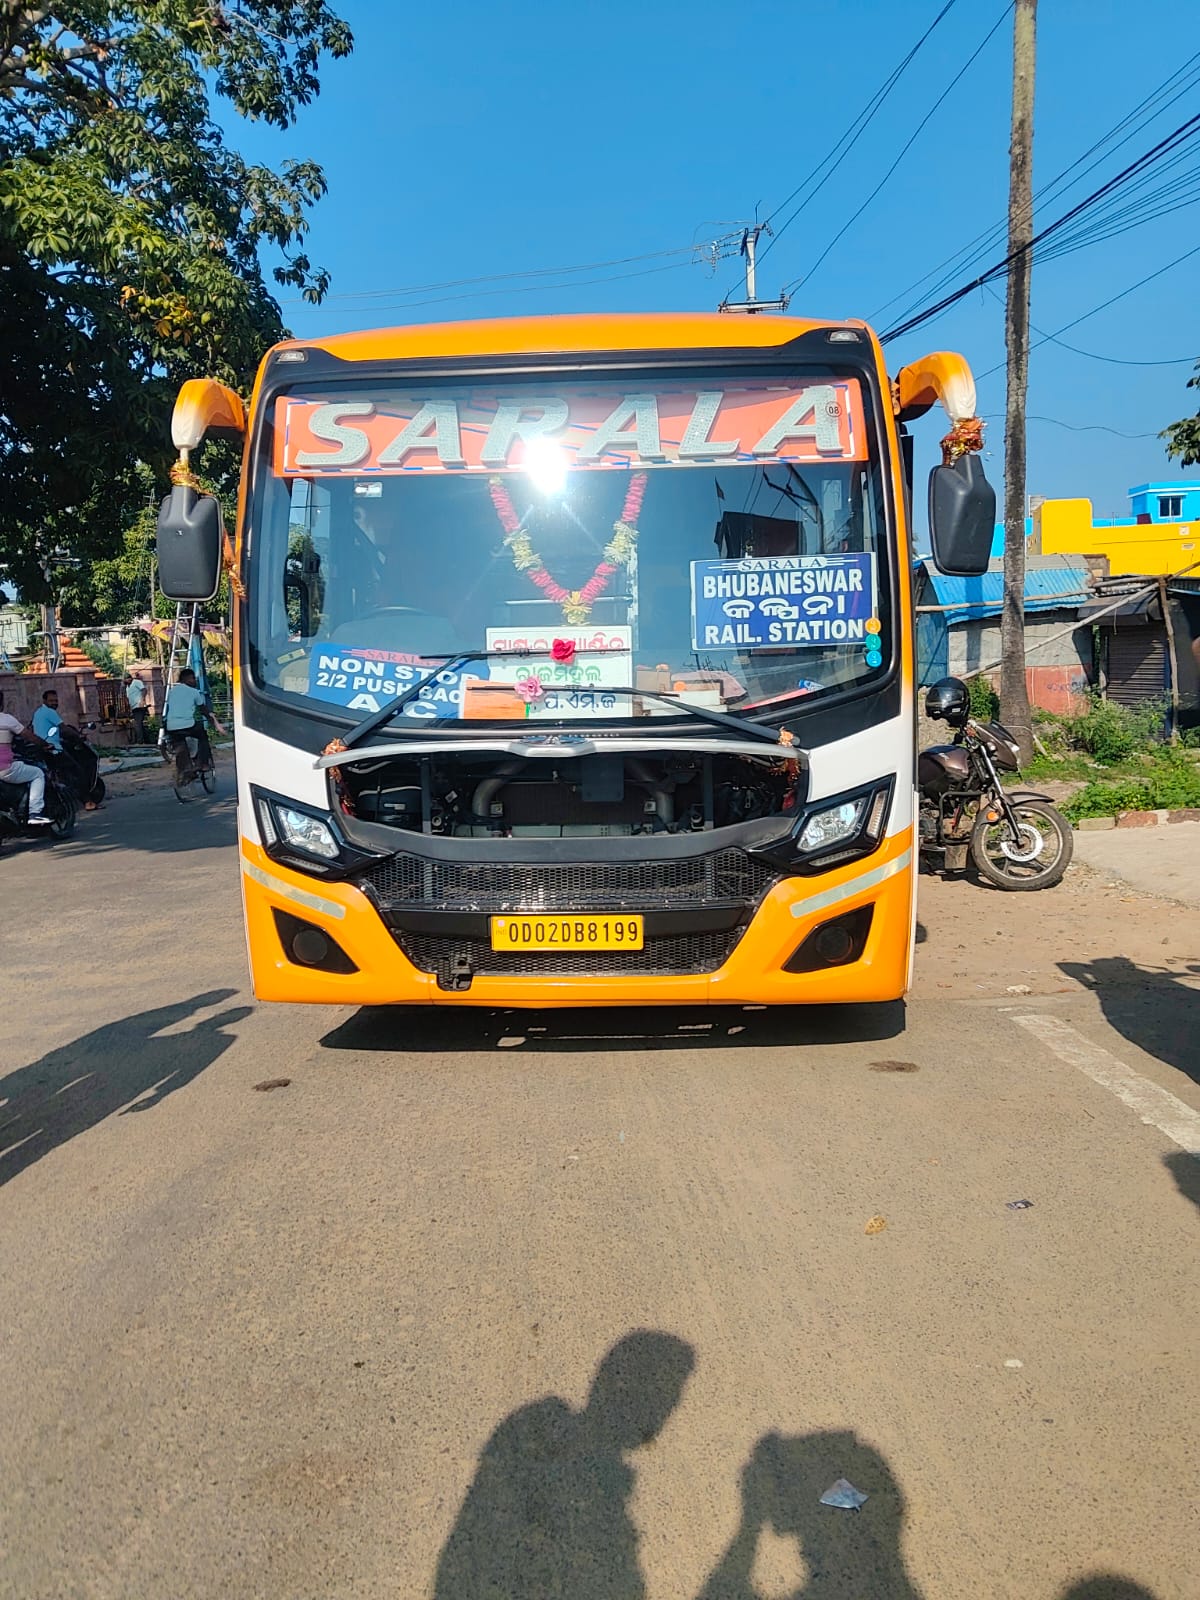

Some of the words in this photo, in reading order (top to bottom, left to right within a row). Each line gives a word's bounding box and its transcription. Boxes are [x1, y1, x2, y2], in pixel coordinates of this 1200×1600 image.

[295, 385, 844, 466] SARALA
[742, 558, 823, 571] SARALA
[703, 569, 863, 598] BHUBANESWAR
[705, 623, 762, 645] RAIL.
[768, 618, 864, 641] STATION
[318, 655, 384, 677] NON
[316, 672, 348, 689] 2/2
[352, 676, 412, 697] PUSH
[418, 685, 464, 704] BAC
[509, 922, 638, 943] OD02DB8199
